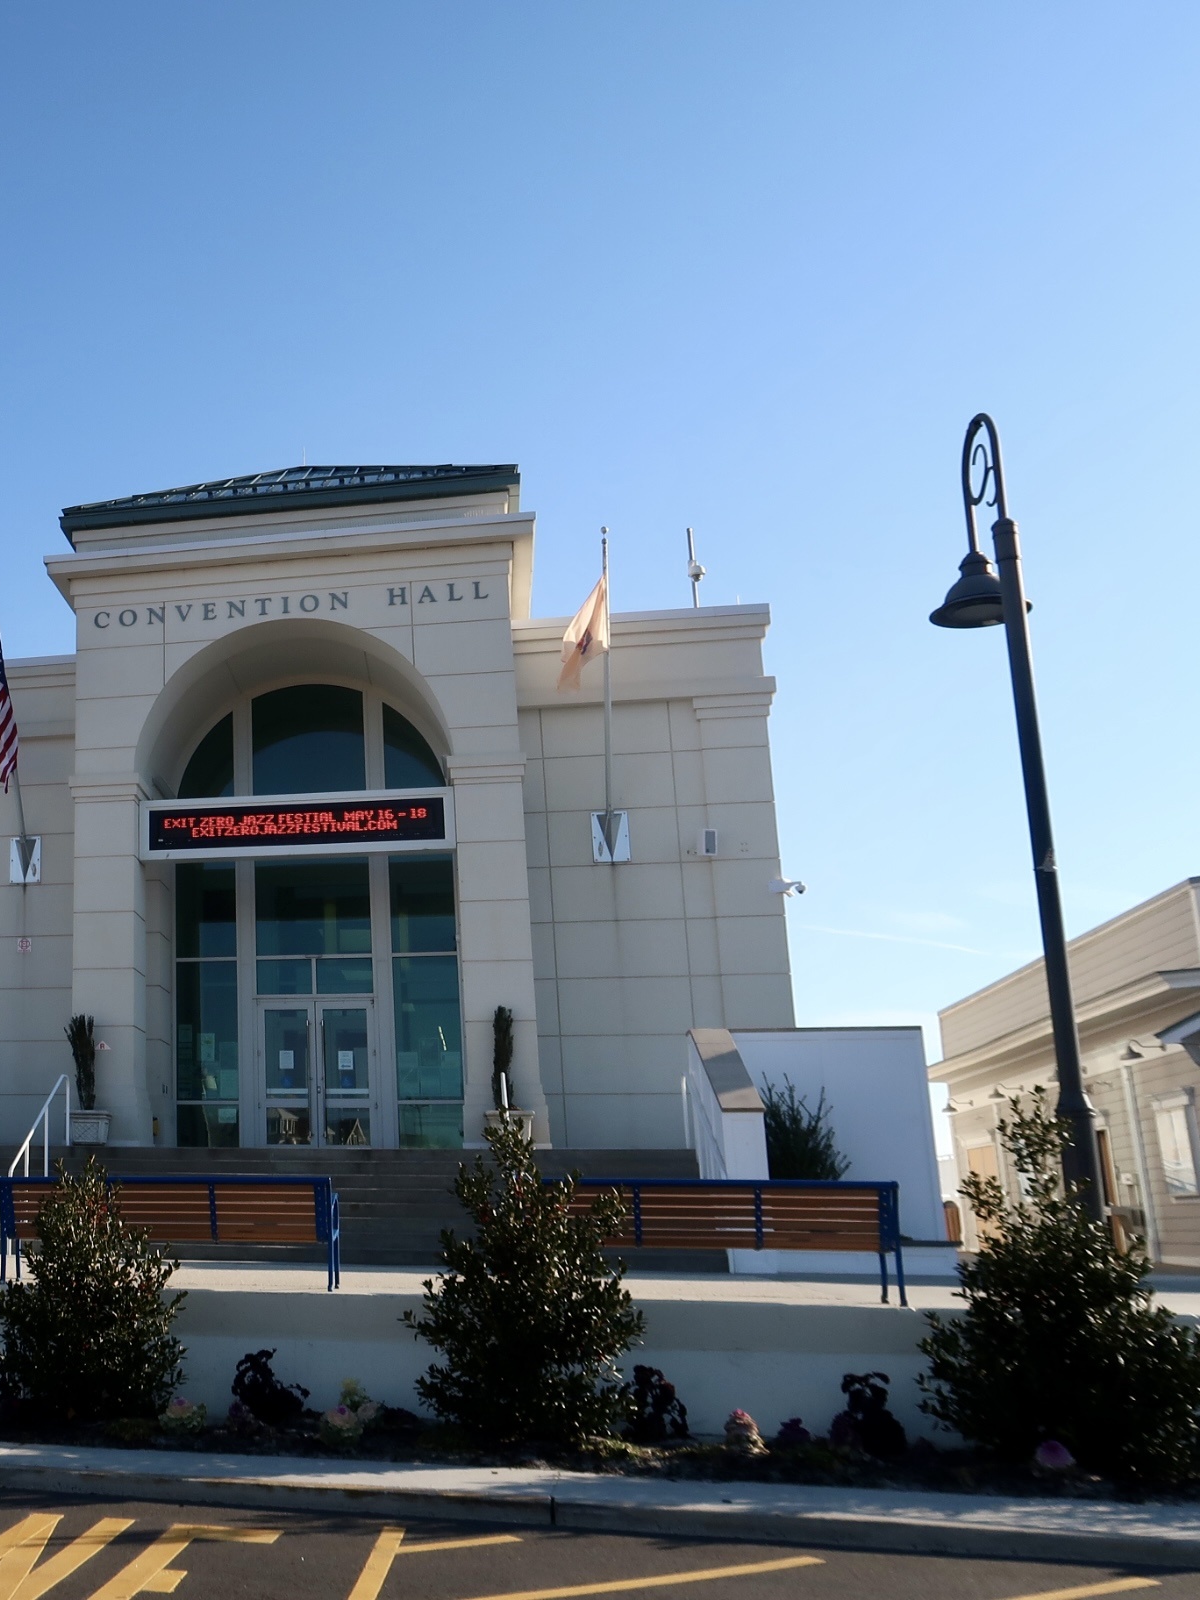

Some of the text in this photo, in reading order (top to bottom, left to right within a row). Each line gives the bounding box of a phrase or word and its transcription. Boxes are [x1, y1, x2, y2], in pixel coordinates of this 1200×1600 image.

[93, 581, 490, 629] CONVENTION HALL
[163, 817, 196, 829] EXIT
[199, 815, 235, 827] ZERO
[238, 813, 275, 826] JAZZ
[278, 811, 337, 825] FESTIAL
[343, 809, 374, 821] MAY
[377, 809, 395, 820] 16
[409, 807, 428, 819] 18
[191, 820, 398, 838] EXITZEROJAZZFESTIVAL.COM
